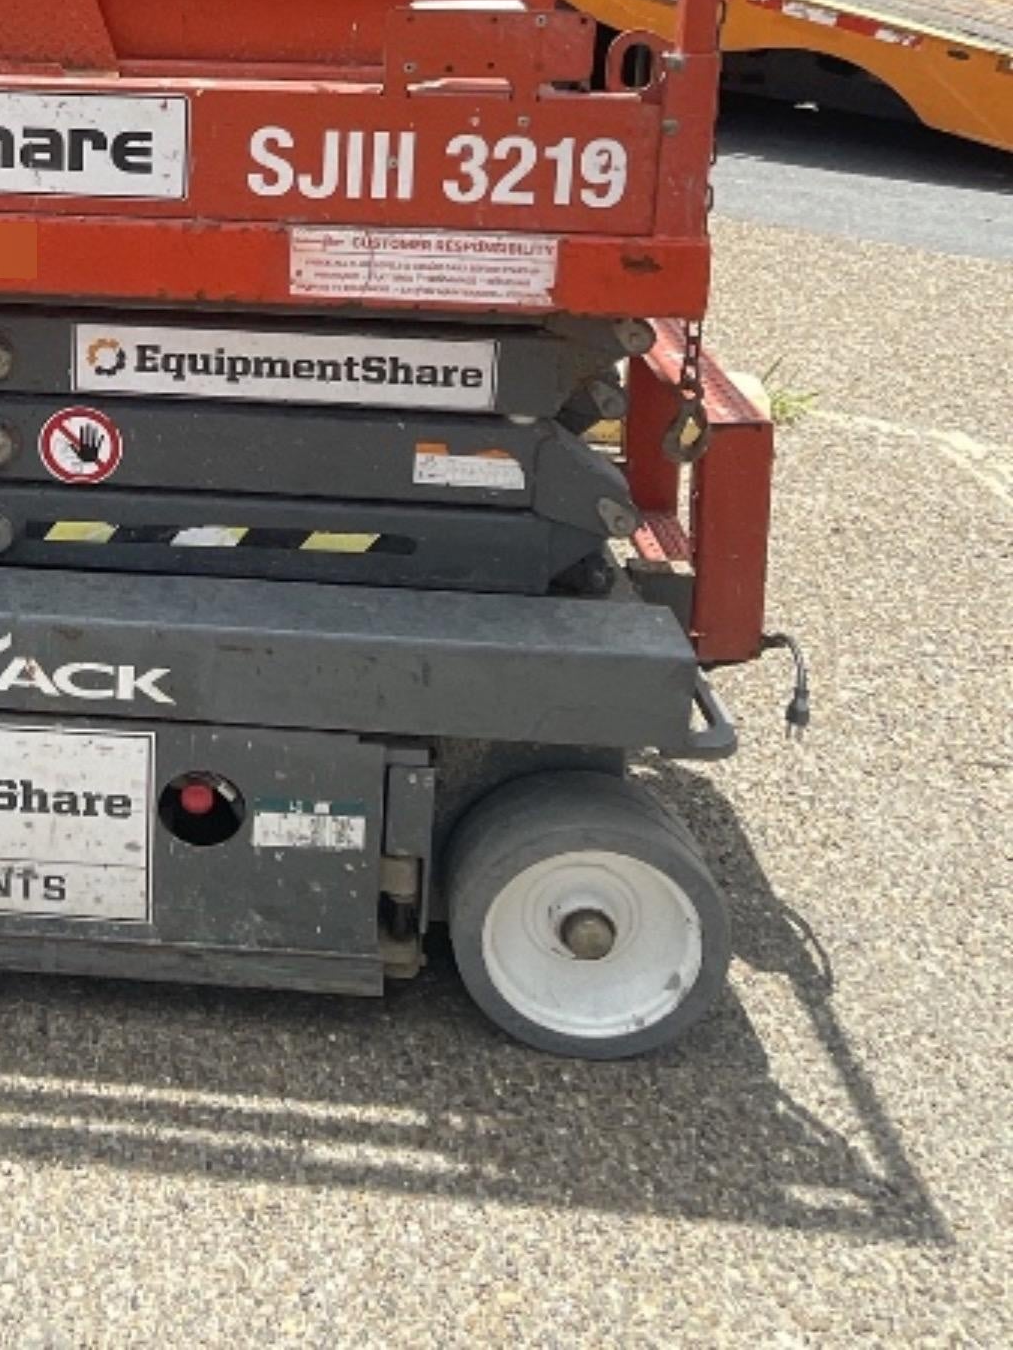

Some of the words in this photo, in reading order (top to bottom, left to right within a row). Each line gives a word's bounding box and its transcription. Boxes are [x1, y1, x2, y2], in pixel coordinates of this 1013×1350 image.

[247, 127, 416, 200] SJIII
[442, 134, 628, 209] 3219
[133, 344, 484, 389] EquipmentShare
